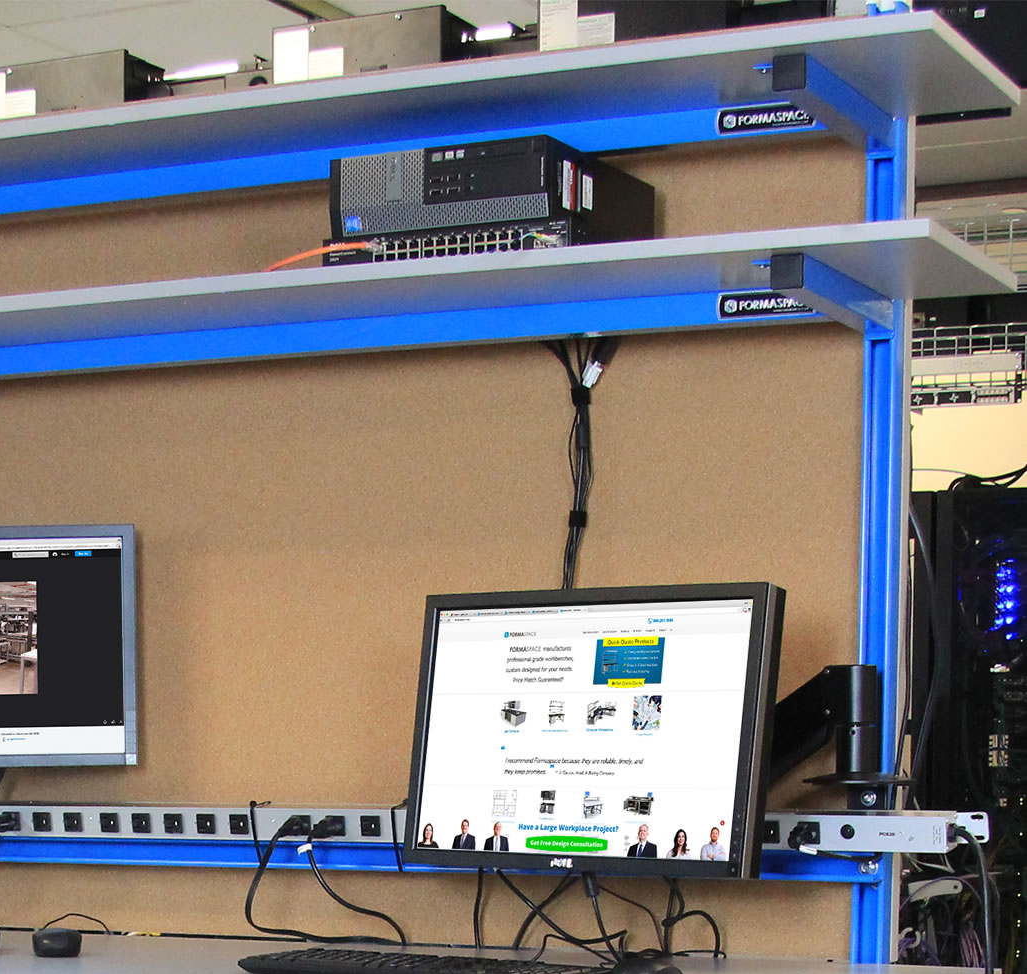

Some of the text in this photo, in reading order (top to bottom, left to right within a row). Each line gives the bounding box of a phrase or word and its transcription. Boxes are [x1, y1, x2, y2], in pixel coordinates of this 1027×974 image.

[739, 298, 804, 311] FORMASPA
[540, 824, 557, 832] Large
[559, 824, 592, 833] Workplace
[593, 825, 619, 833] Project?
